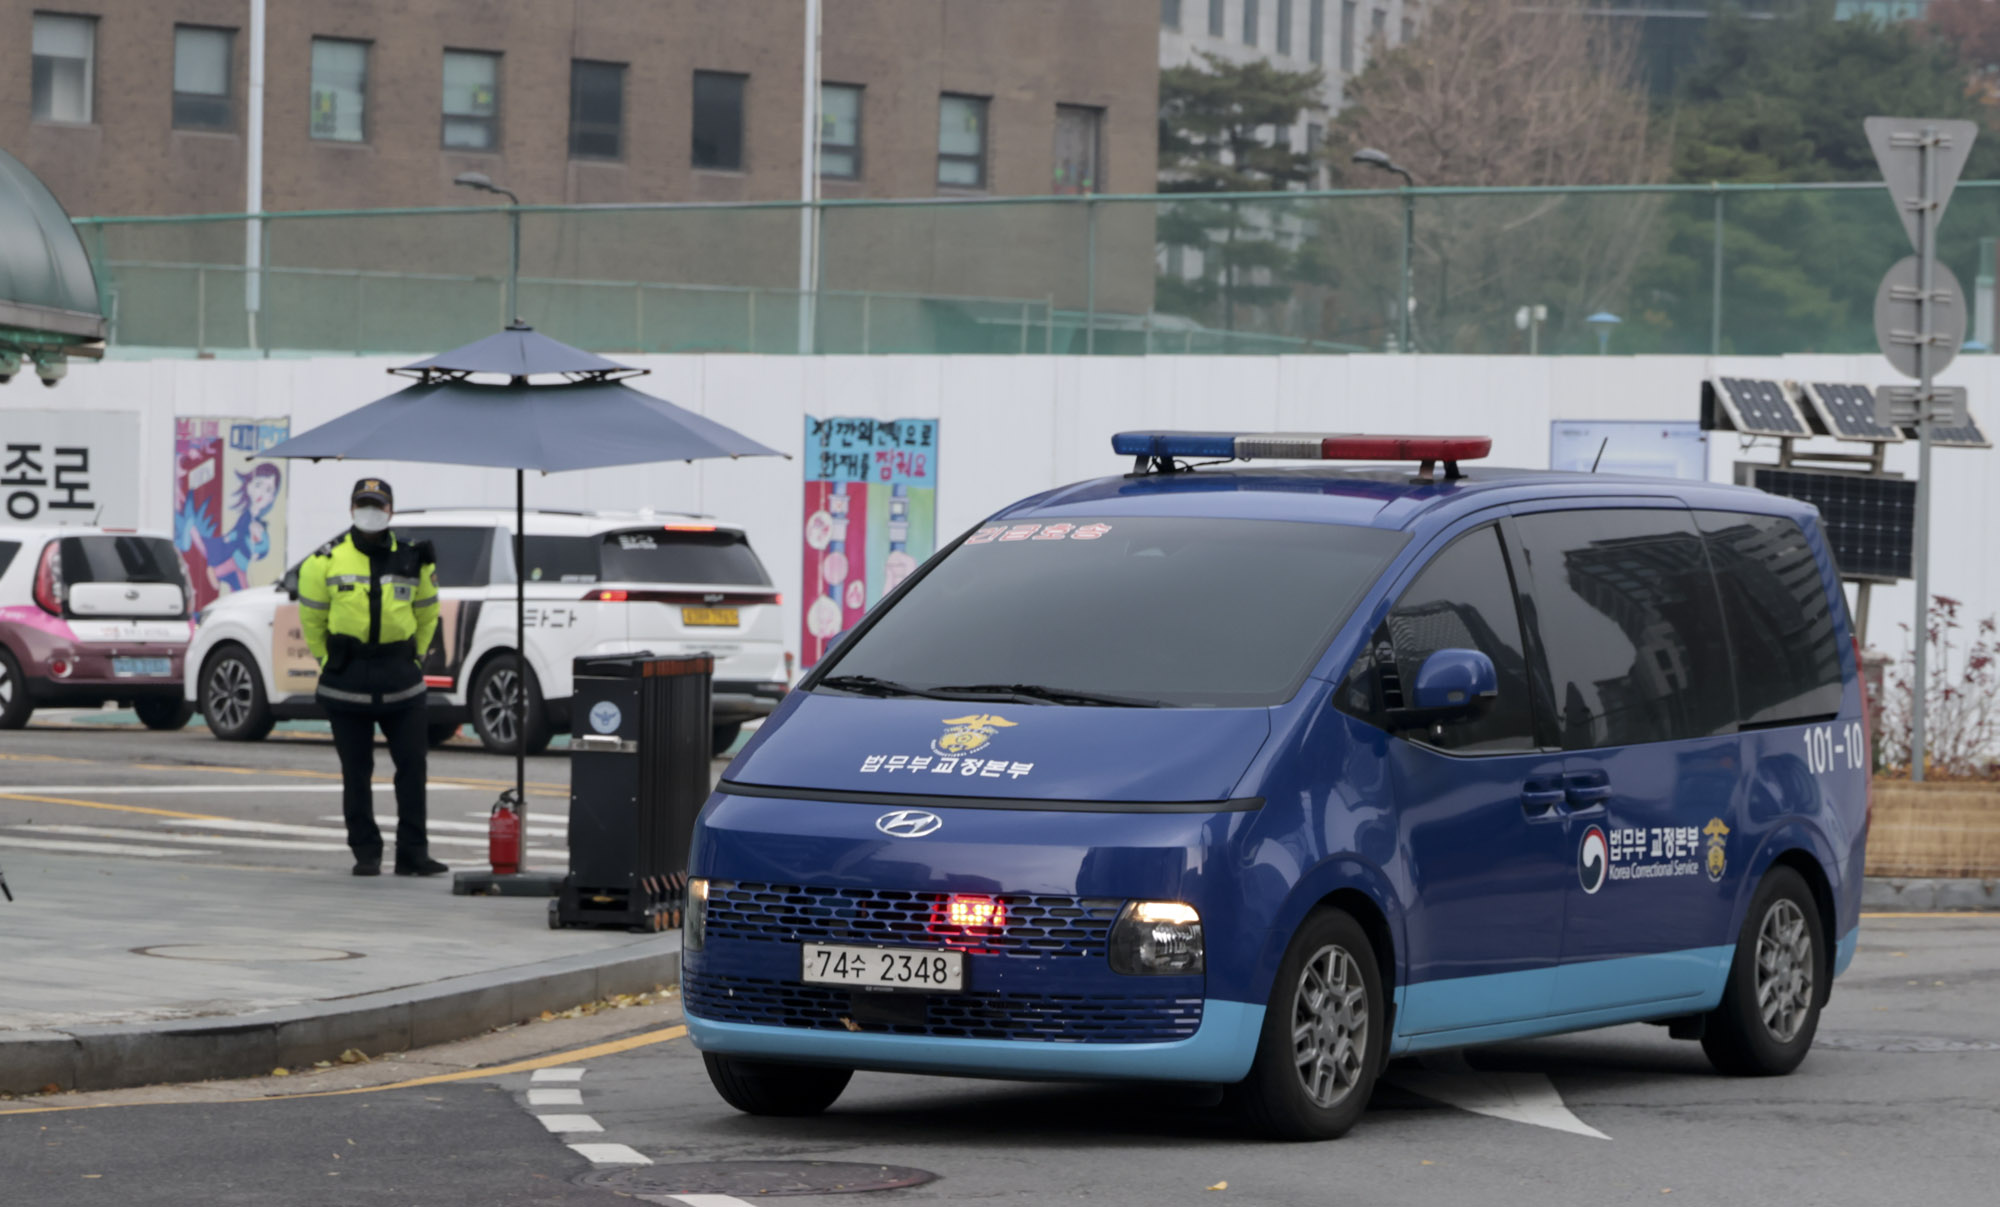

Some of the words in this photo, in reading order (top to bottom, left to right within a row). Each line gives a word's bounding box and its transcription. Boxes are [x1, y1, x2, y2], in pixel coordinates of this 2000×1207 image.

[0, 443, 95, 520] 종로
[1803, 722, 1864, 775] 101-10
[860, 754, 933, 773] 법무부
[931, 757, 1034, 779] 교정본부
[1609, 828, 1647, 861] 법무부
[1650, 826, 1699, 858] 교정본부
[1608, 864, 1630, 880] Korea
[1631, 860, 1673, 879] Correctional
[1673, 859, 1699, 875] Service
[817, 950, 866, 979] 74수
[880, 953, 948, 984] 2348
